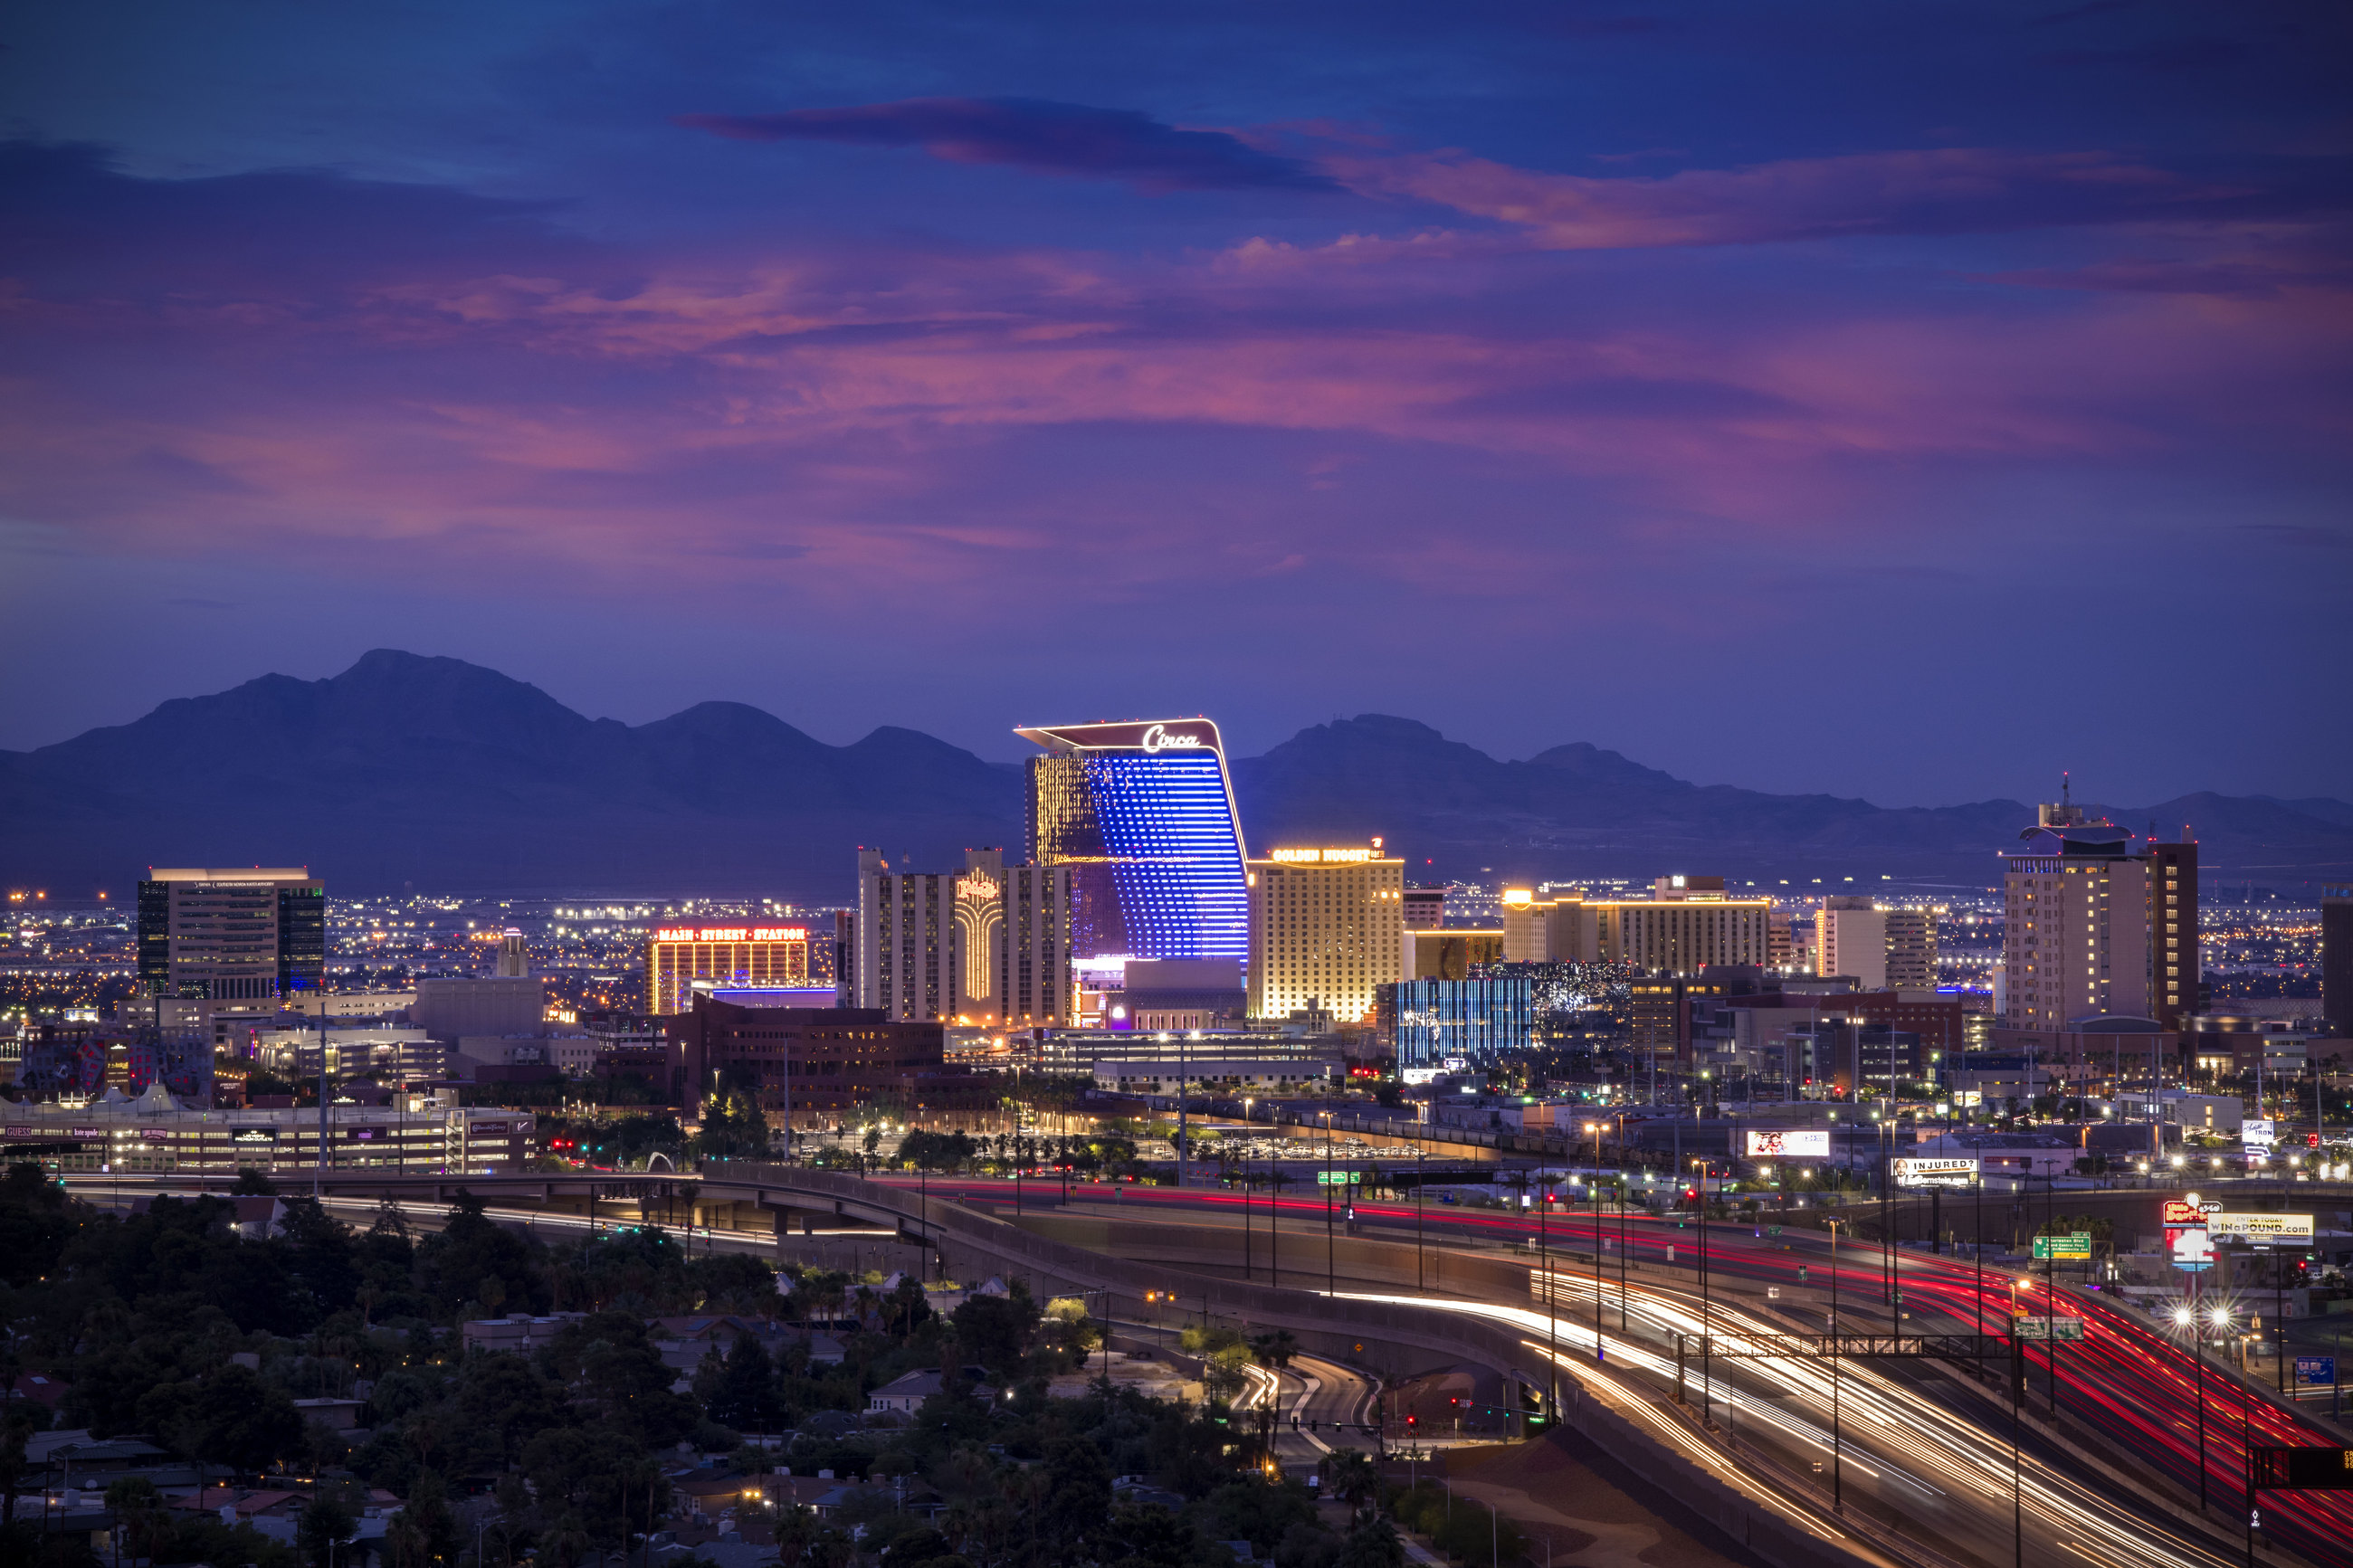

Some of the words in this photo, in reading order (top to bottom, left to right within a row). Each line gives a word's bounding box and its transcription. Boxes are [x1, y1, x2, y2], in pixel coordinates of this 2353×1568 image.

[1143, 725, 1200, 753] Circa
[1273, 850, 1319, 861] GOLDEN
[1322, 850, 1370, 861] NUGGET
[660, 929, 694, 941] MAIN
[700, 929, 747, 940] STREET
[753, 928, 805, 940] STATION
[7, 1126, 31, 1136] GUESS
[1914, 1160, 1974, 1170] INJURED?
[2167, 1203, 2188, 1212] Little
